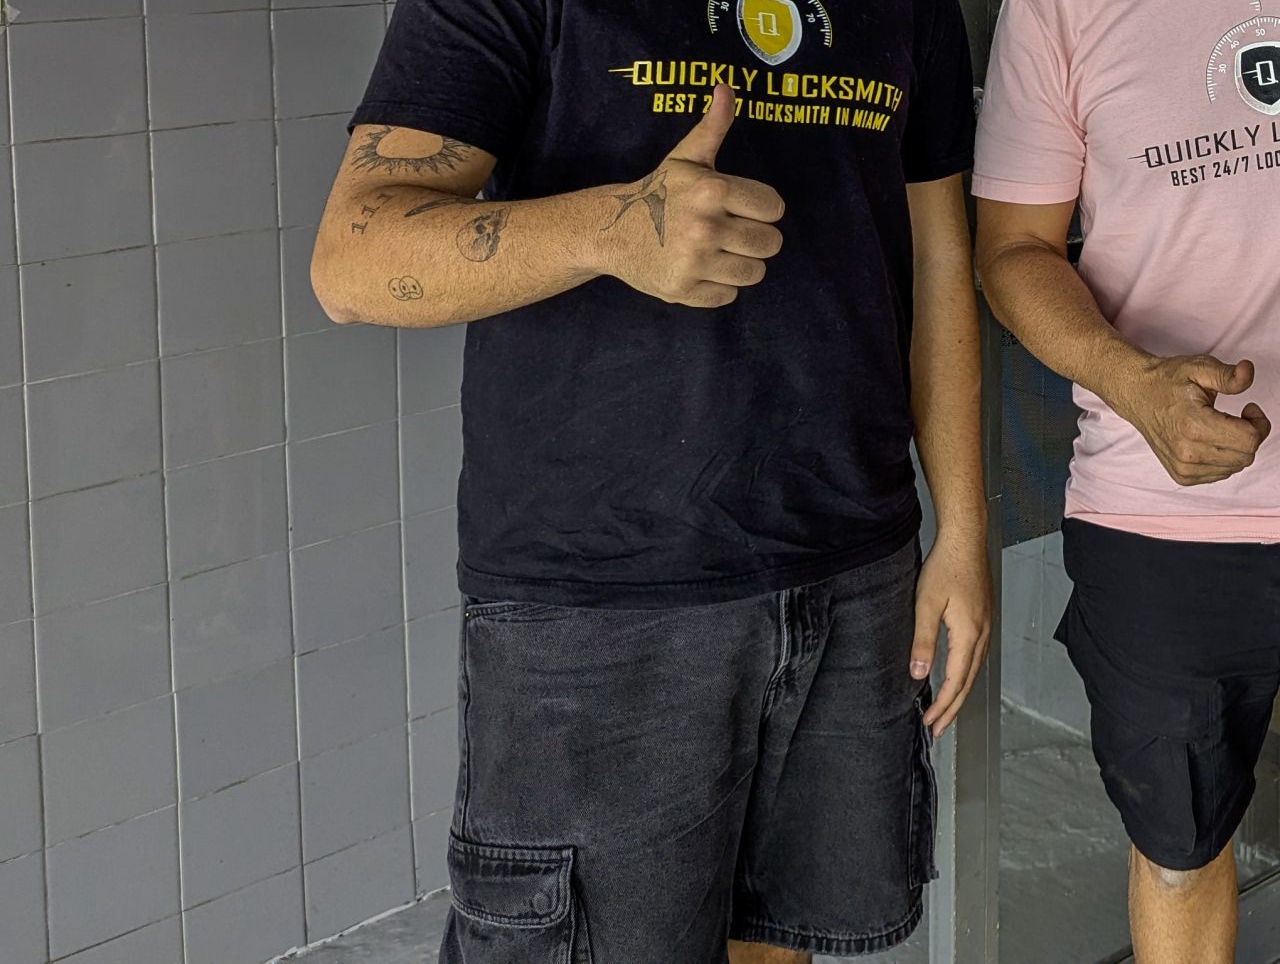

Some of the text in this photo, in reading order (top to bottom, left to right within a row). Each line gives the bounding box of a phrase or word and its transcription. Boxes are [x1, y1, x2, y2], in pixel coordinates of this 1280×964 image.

[720, 1, 730, 12] 30
[805, 13, 816, 23] 70
[1219, 63, 1227, 74] 30
[1230, 40, 1240, 50] 40
[1255, 28, 1266, 37] 50
[622, 60, 903, 112] QUICKLY LOCKSMITH
[653, 93, 696, 113] BEST
[748, 100, 830, 125] LOCKSMITH
[835, 107, 850, 126] IN
[852, 109, 891, 132] MIAMI
[1137, 124, 1261, 169] QUICKLY
[1170, 164, 1206, 187] BEST
[1213, 155, 1249, 179] 24/7
